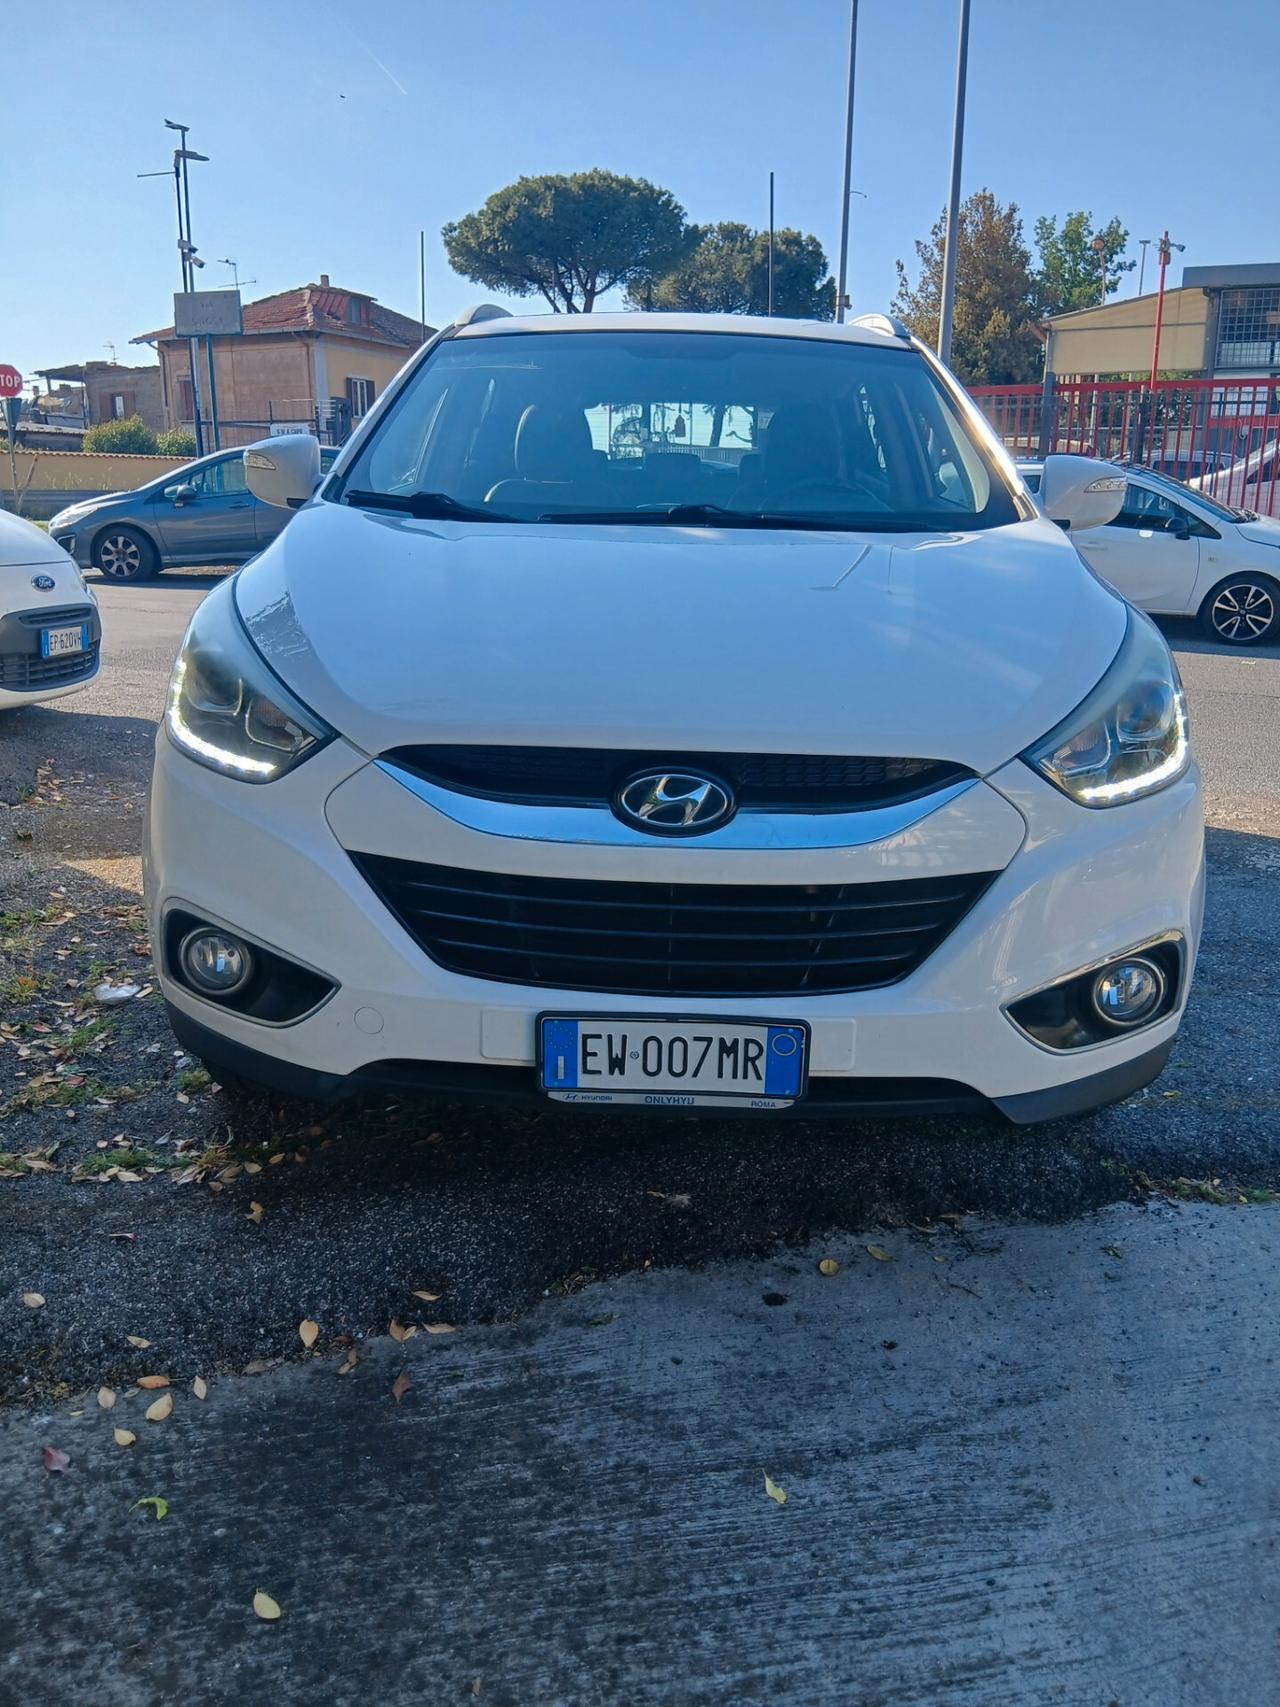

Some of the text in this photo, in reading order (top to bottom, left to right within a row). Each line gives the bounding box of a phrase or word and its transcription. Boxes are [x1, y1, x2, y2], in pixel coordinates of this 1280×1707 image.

[0, 374, 21, 388] TOP
[581, 1033, 764, 1080] EW 007MR
[751, 1100, 776, 1108] ROMA
